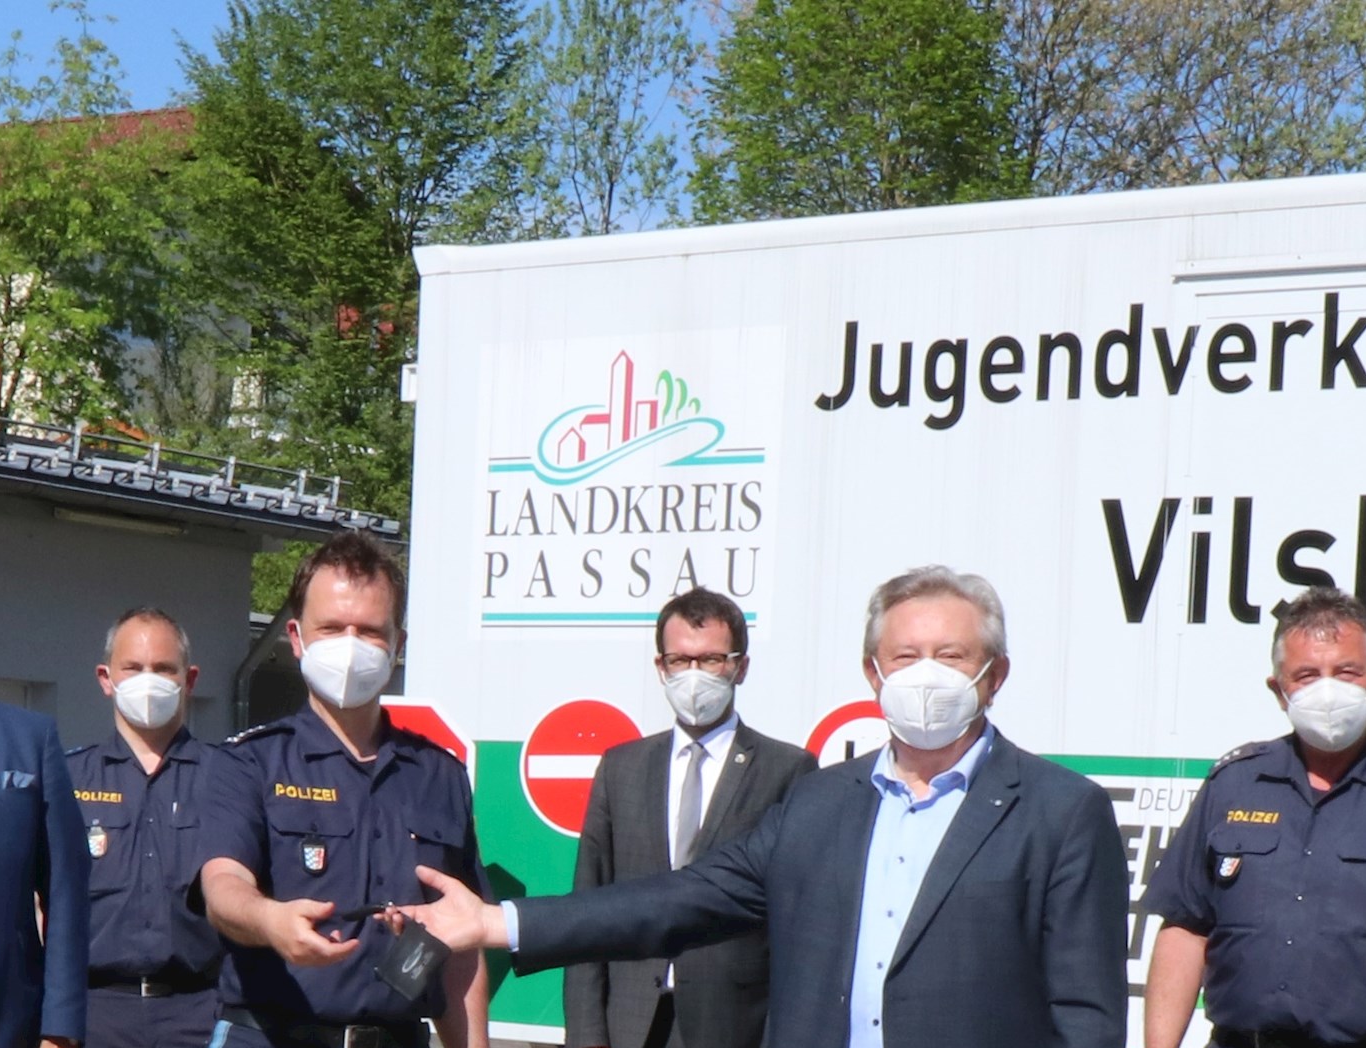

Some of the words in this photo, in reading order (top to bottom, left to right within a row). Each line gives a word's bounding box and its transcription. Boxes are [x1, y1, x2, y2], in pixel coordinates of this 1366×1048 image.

[485, 480, 763, 537] LANDKREIS
[482, 546, 761, 600] PASSAU
[73, 789, 123, 803] POLIZEI
[275, 783, 337, 802] POLIZEI
[1226, 810, 1280, 824] POLIZEI
